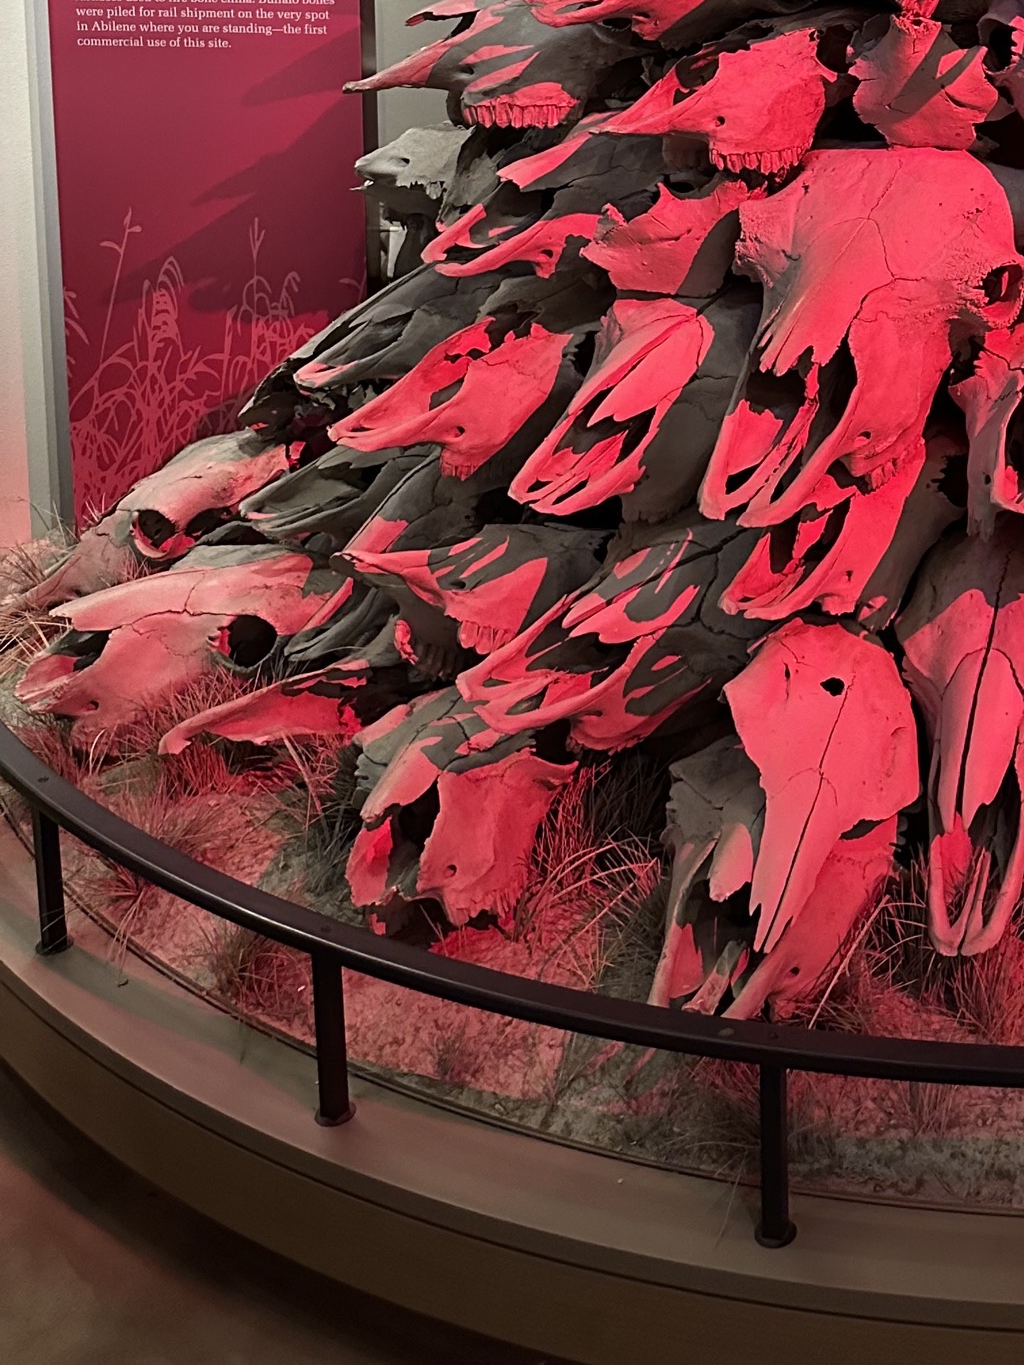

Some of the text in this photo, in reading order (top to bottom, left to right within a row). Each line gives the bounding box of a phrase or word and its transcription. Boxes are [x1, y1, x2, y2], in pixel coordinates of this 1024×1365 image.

[75, 5, 330, 22] were piled for rail shipment on the very spot
[76, 20, 88, 31] in
[91, 20, 136, 32] Abilene
[138, 21, 175, 32] where
[177, 24, 199, 35] you
[201, 24, 220, 33] are
[304, 23, 327, 35] first
[76, 35, 232, 48] commercial use of this site.
